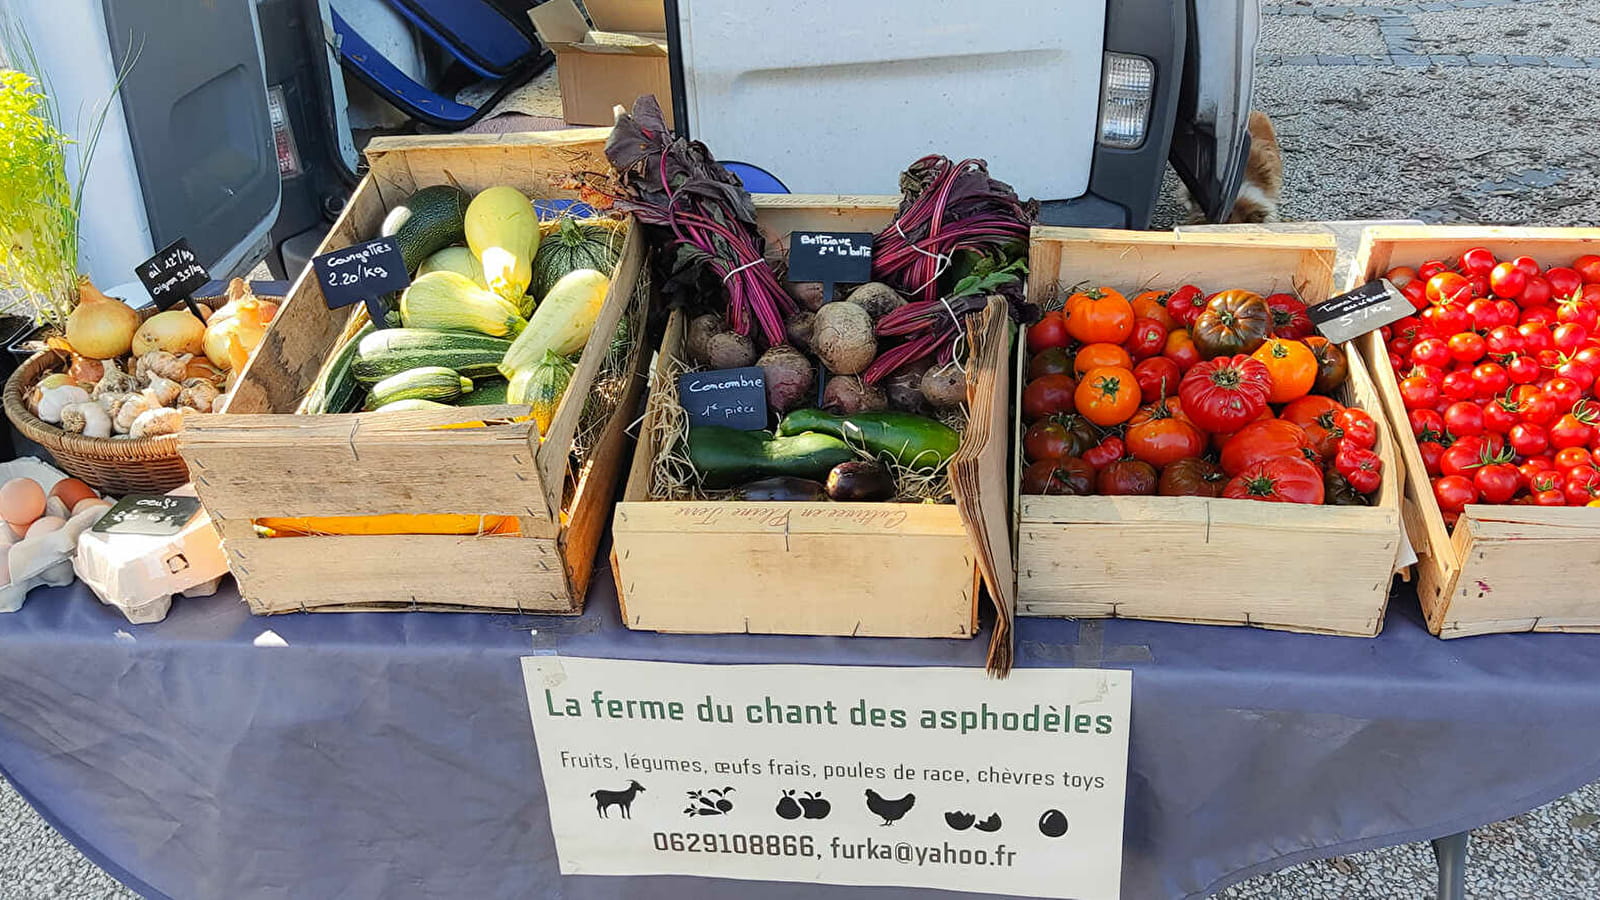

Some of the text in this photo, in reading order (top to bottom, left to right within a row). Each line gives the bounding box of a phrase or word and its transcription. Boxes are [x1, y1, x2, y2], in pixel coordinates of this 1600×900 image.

[800, 234, 851, 246] Betterave
[327, 242, 393, 267] Courgettes
[837, 246, 847, 256] la
[849, 245, 872, 257] botte
[689, 374, 764, 392] Concombre
[725, 400, 756, 419] pièce
[800, 508, 826, 518] en
[545, 688, 1113, 735] La ferme du chant des asphodèles
[560, 751, 1105, 791] Fruits, légumes, œufs frais, poules de race, chèvres toys
[653, 832, 1017, 867] 0629108866, furka@yahoo.fr
